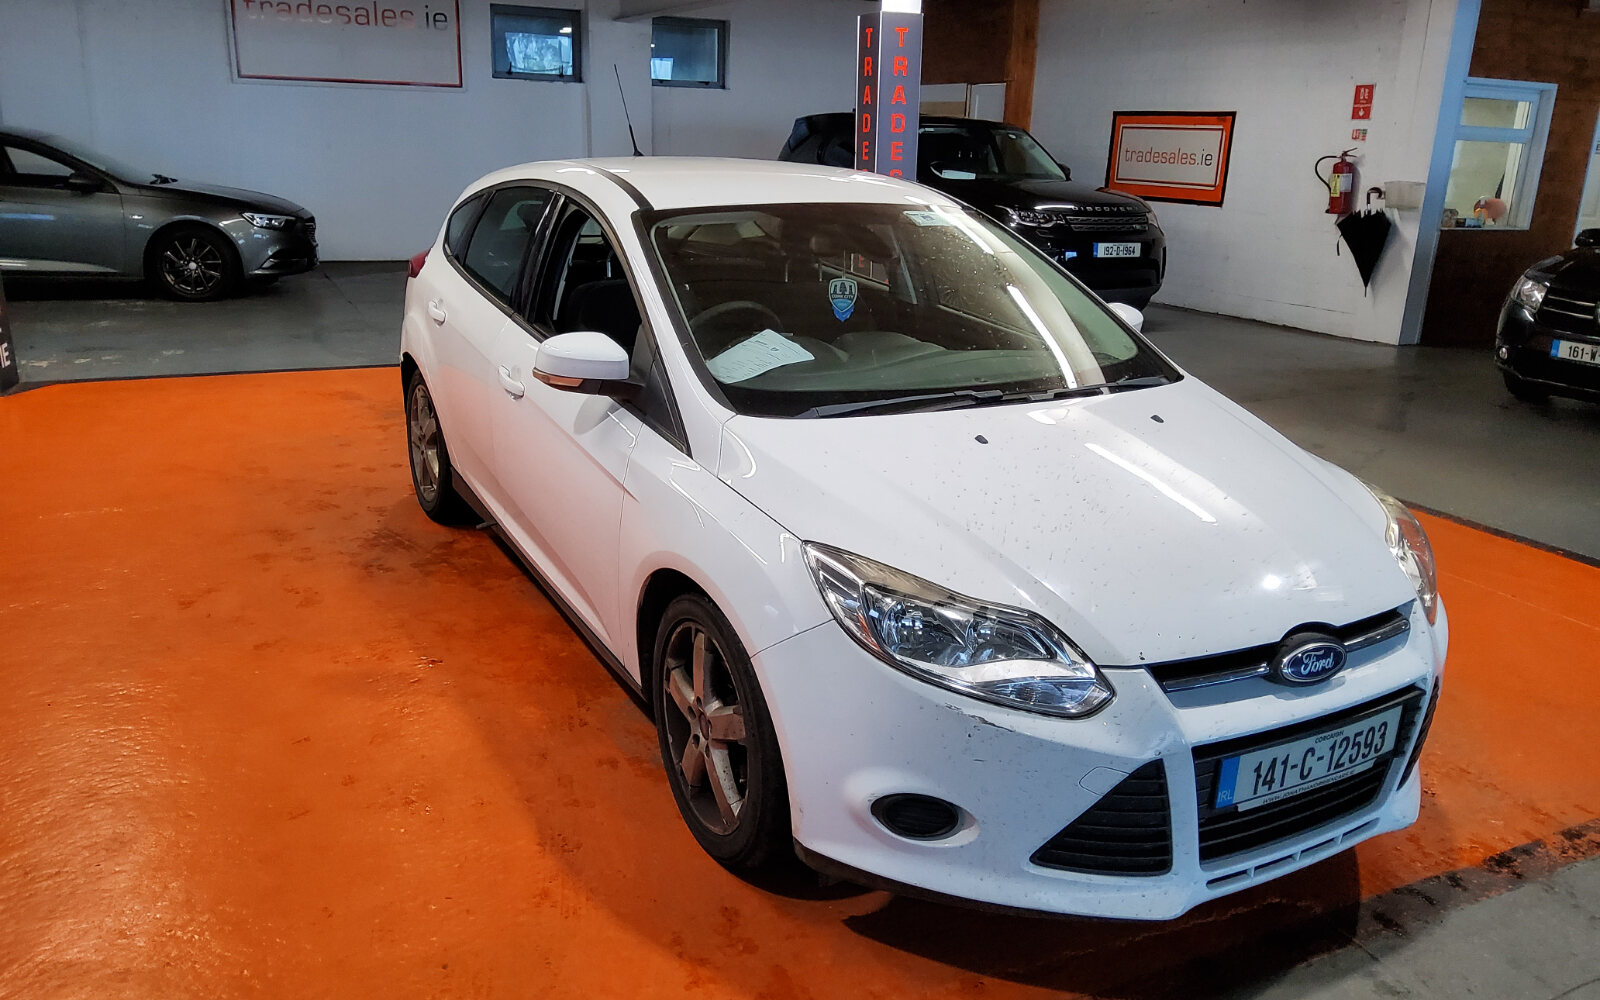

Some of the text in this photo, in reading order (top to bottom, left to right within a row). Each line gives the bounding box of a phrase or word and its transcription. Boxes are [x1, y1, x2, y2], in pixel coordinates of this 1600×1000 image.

[860, 27, 873, 172] TRADE
[1125, 146, 1213, 167] tradesales.ie
[1301, 650, 1335, 675] Ford
[1253, 721, 1389, 796] 141-C-12593
